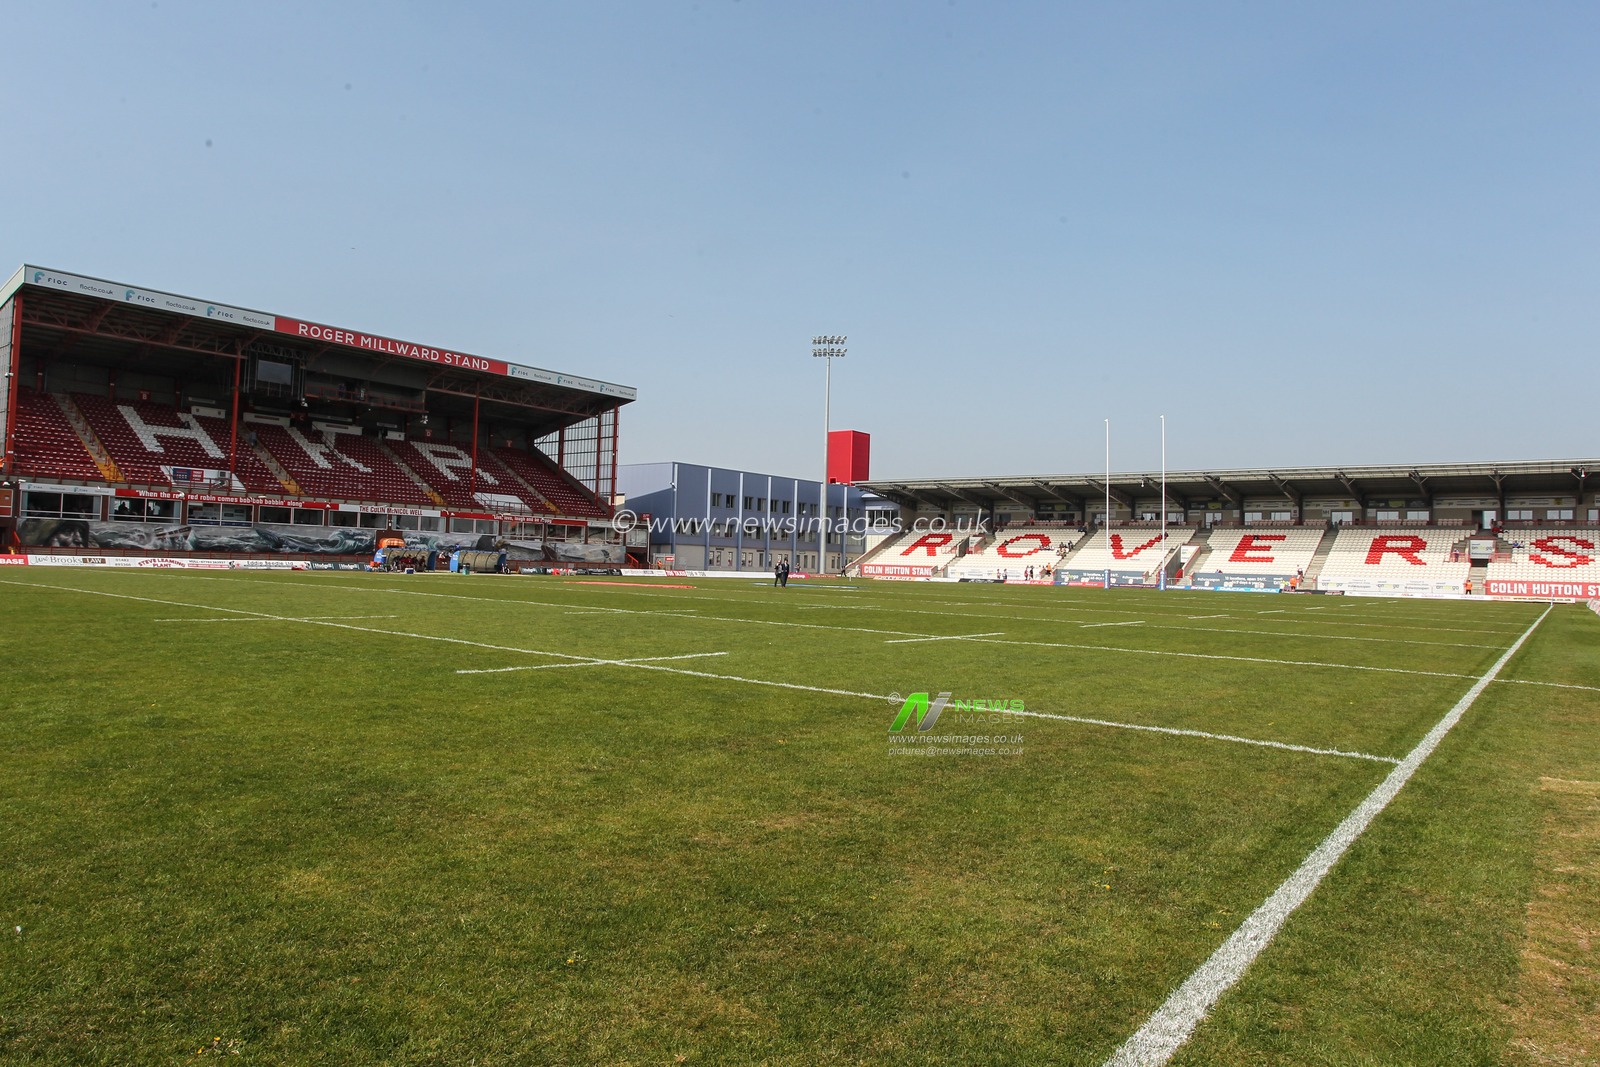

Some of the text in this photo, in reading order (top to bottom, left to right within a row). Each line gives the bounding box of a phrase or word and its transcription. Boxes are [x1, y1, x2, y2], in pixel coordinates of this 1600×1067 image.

[298, 323, 489, 370] ROGER MILLWARD STAND
[160, 491, 171, 499] the
[200, 494, 216, 502] robin
[50, 556, 82, 564] Brooks
[138, 558, 157, 566] STEVE
[157, 558, 186, 568] LEAMING
[863, 565, 883, 574] COLIN
[885, 566, 910, 576] HUTTON
[1490, 582, 1527, 594] COLIN
[1532, 583, 1582, 596] HUTTON
